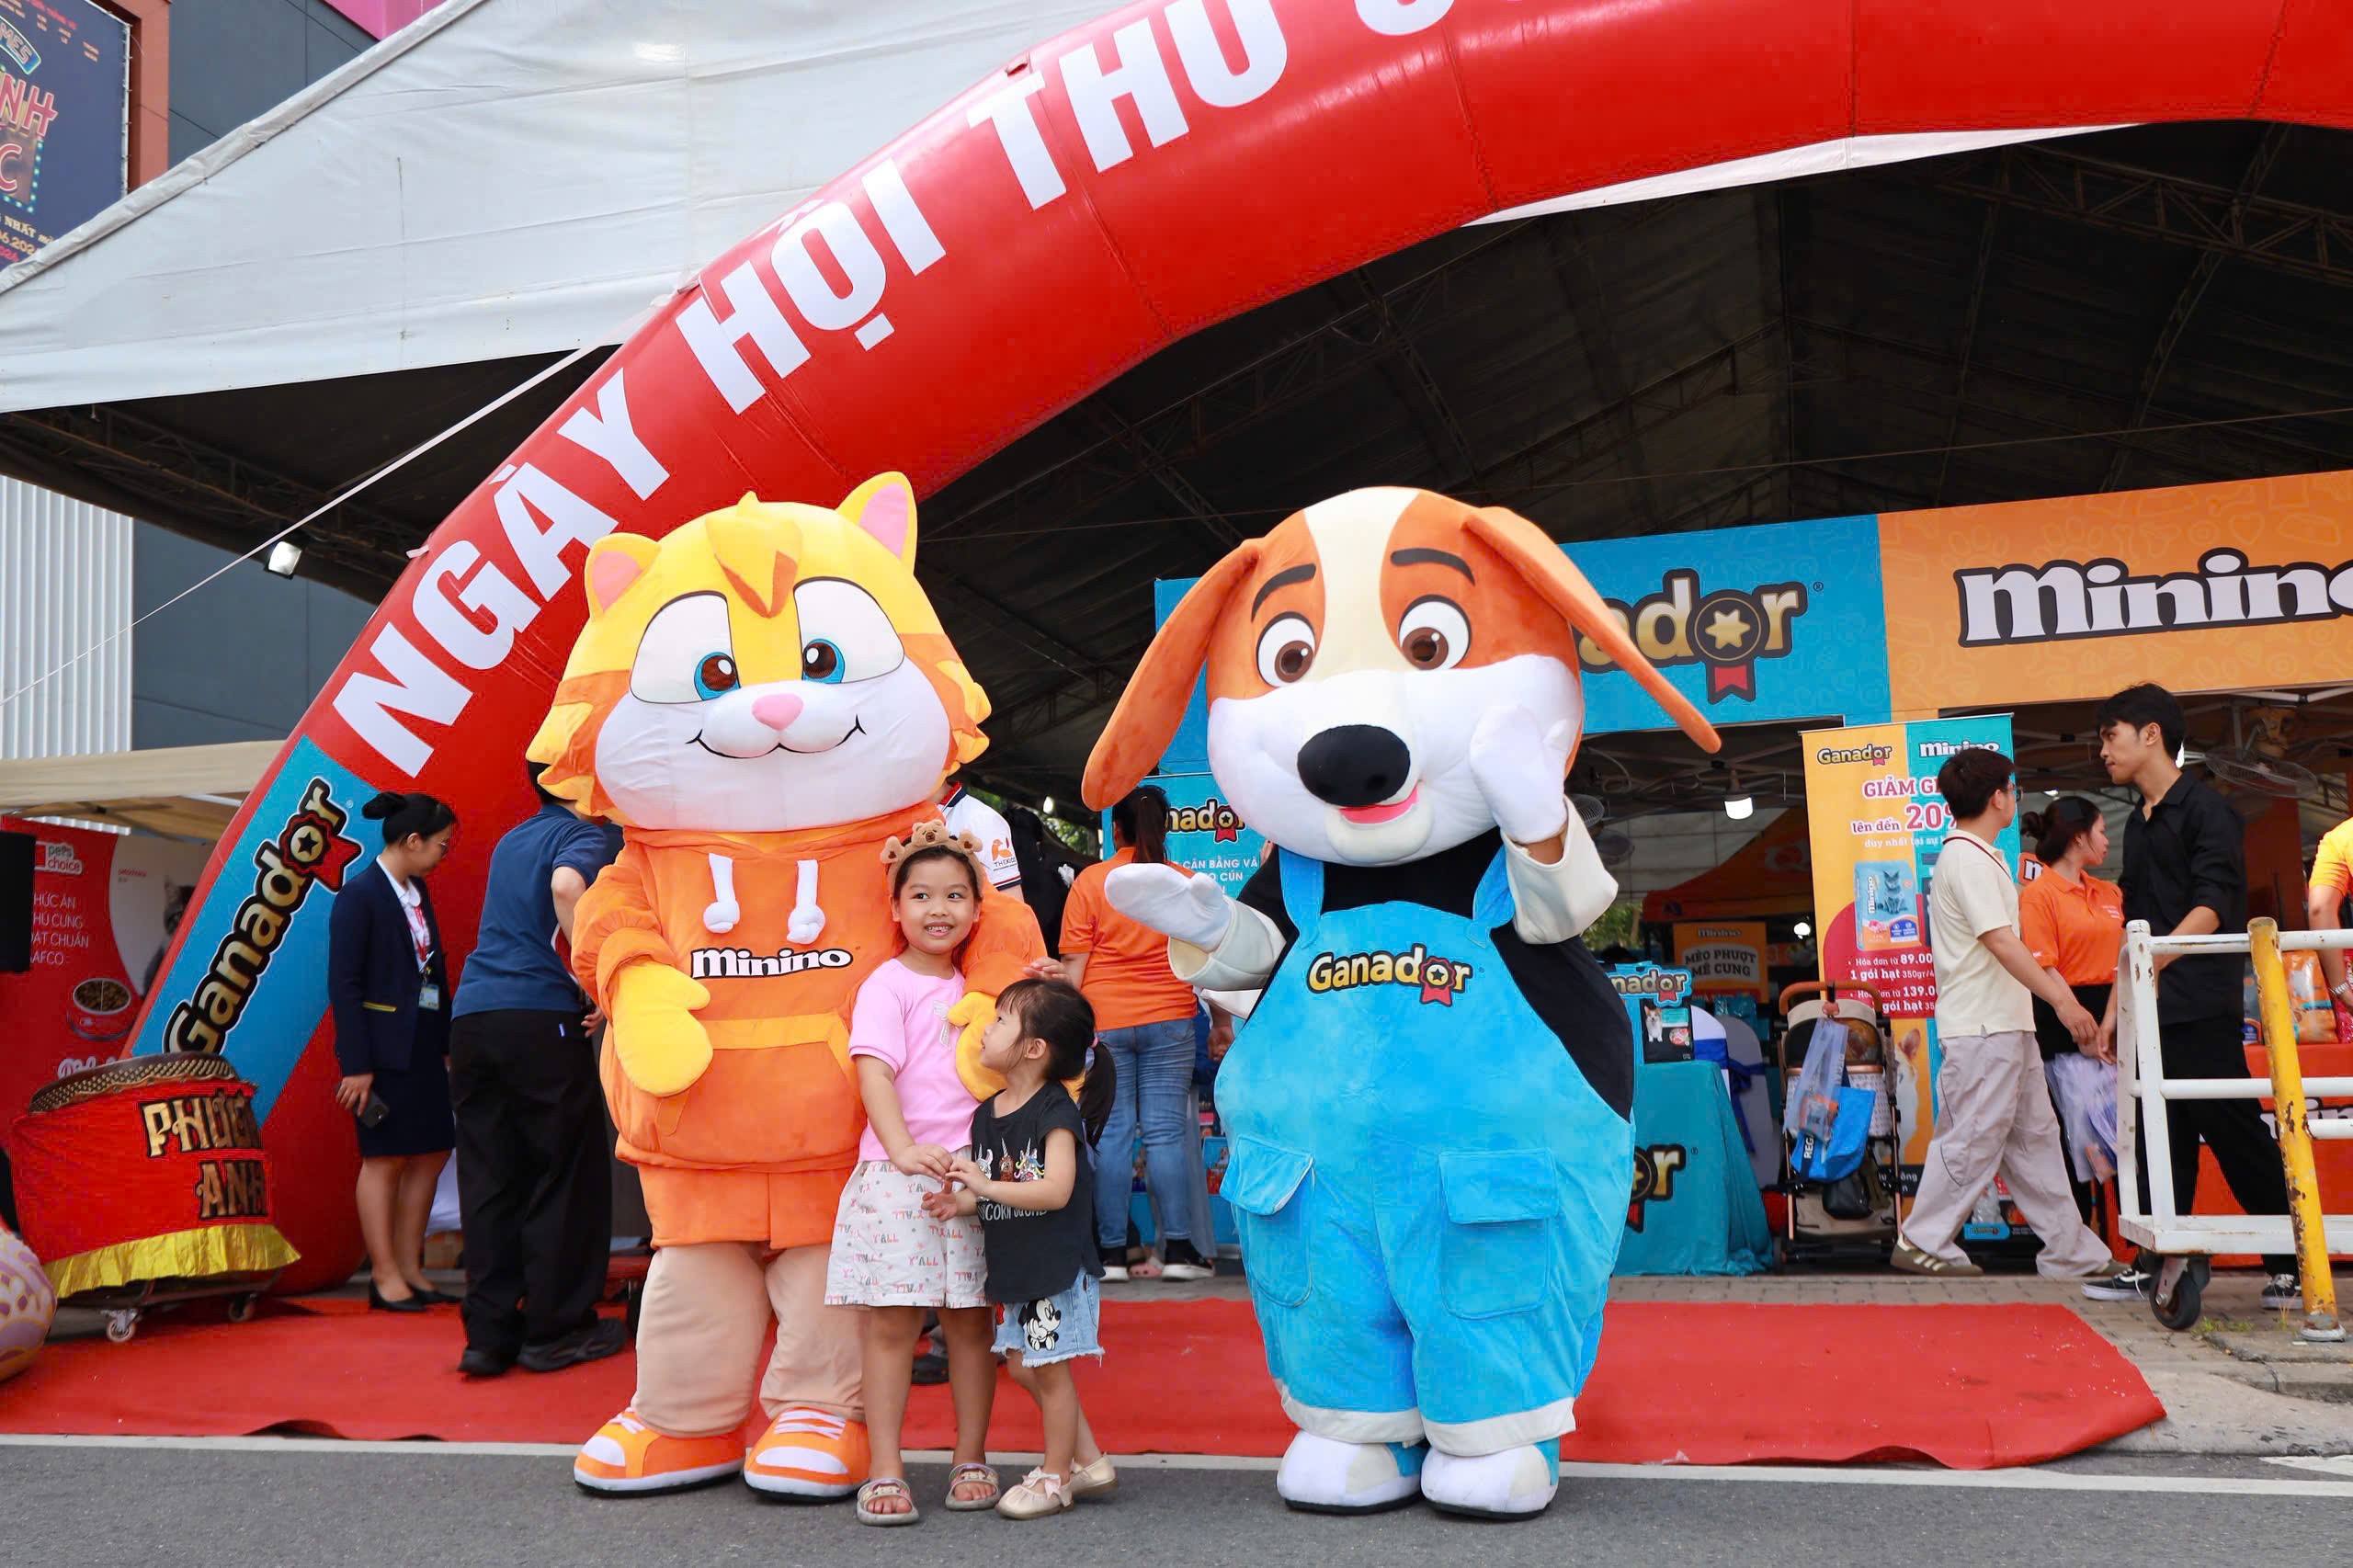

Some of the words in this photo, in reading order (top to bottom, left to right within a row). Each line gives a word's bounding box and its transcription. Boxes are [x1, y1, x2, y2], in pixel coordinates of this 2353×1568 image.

[333, 368, 669, 778] NGÀY
[676, 158, 946, 415] HỘI
[1817, 744, 1893, 765] Ganador
[1863, 776, 1915, 798] GIẢM
[1921, 778, 1942, 795] GI
[47, 857, 81, 872] choice
[1900, 953, 1933, 965] 89.00
[1306, 943, 1473, 997] Ganador
[1611, 969, 1688, 994] nador
[1904, 985, 1936, 997] 139.0
